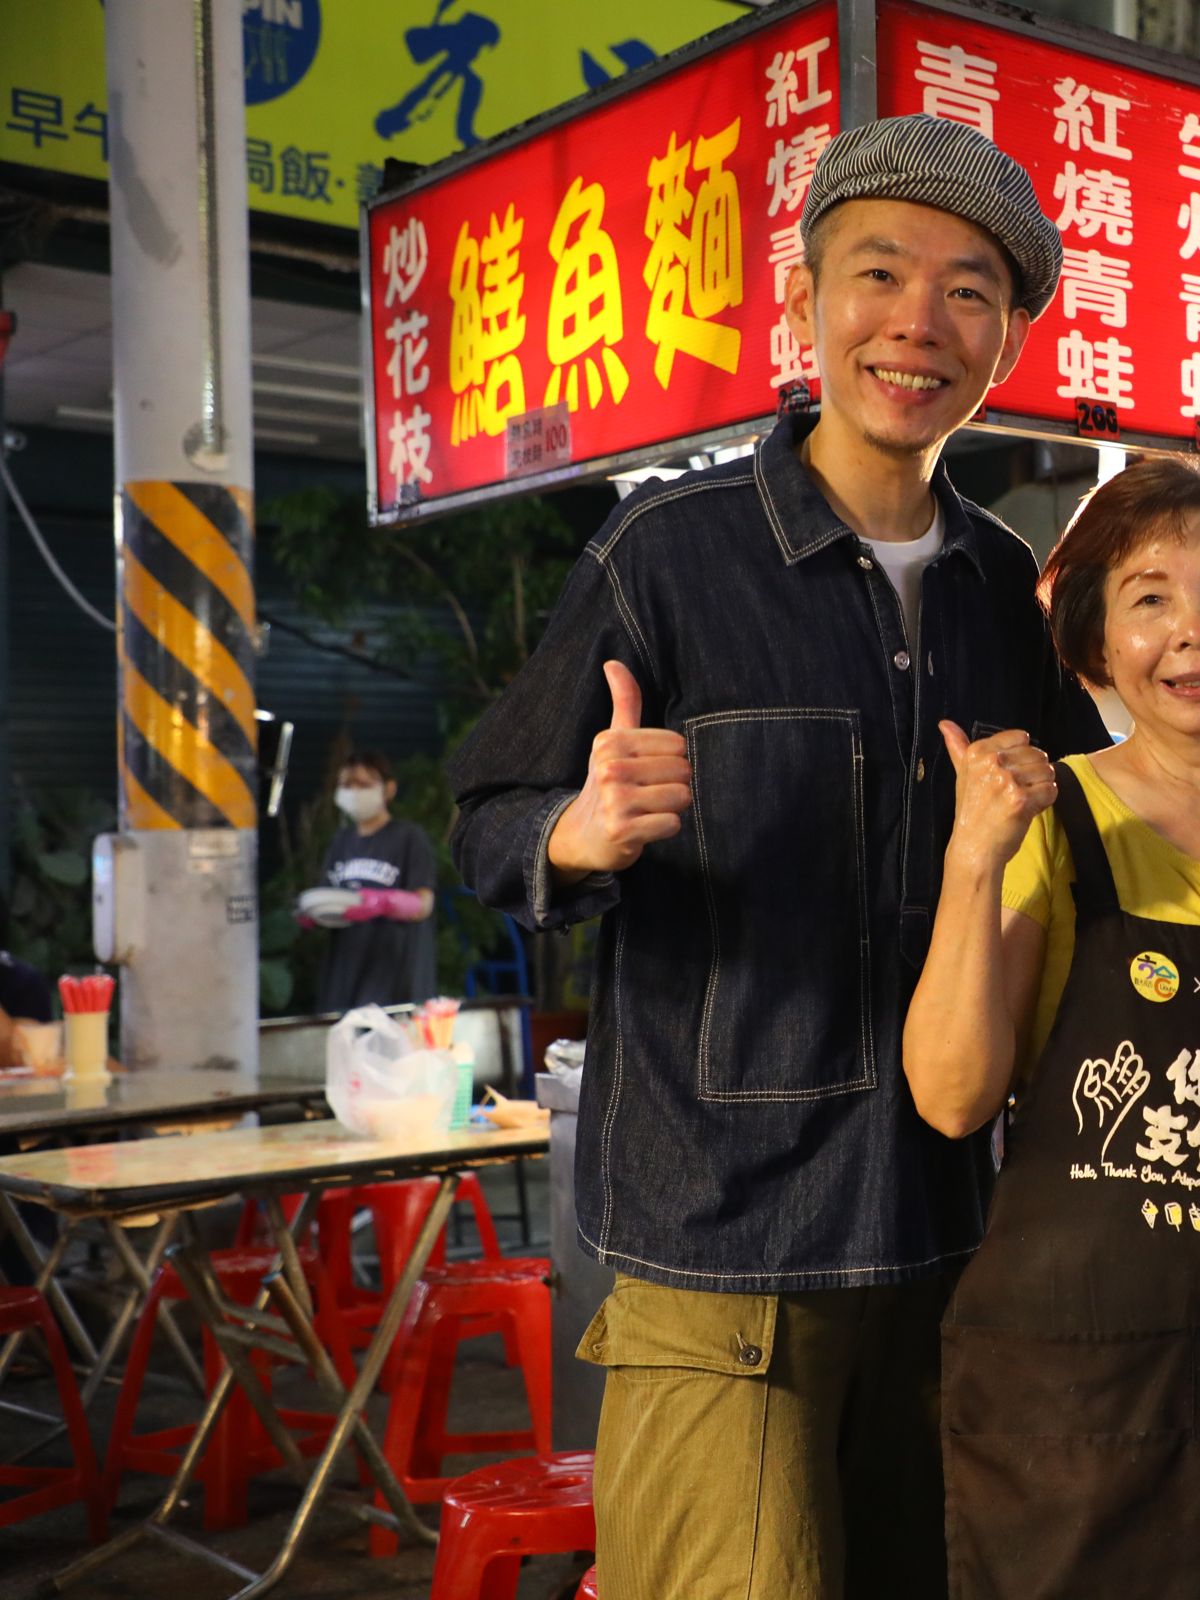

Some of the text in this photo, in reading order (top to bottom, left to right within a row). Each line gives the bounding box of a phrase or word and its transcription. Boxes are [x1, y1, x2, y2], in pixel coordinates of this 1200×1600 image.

[383, 217, 433, 484] 炒花枝
[450, 116, 743, 447] 鱔魚麵
[1052, 77, 1136, 410] 紅燒青蛙
[1077, 402, 1118, 433] 200
[1070, 1163, 1097, 1180] Hello,
[1101, 1162, 1137, 1178] Thank
[1141, 1164, 1166, 1185] You,
